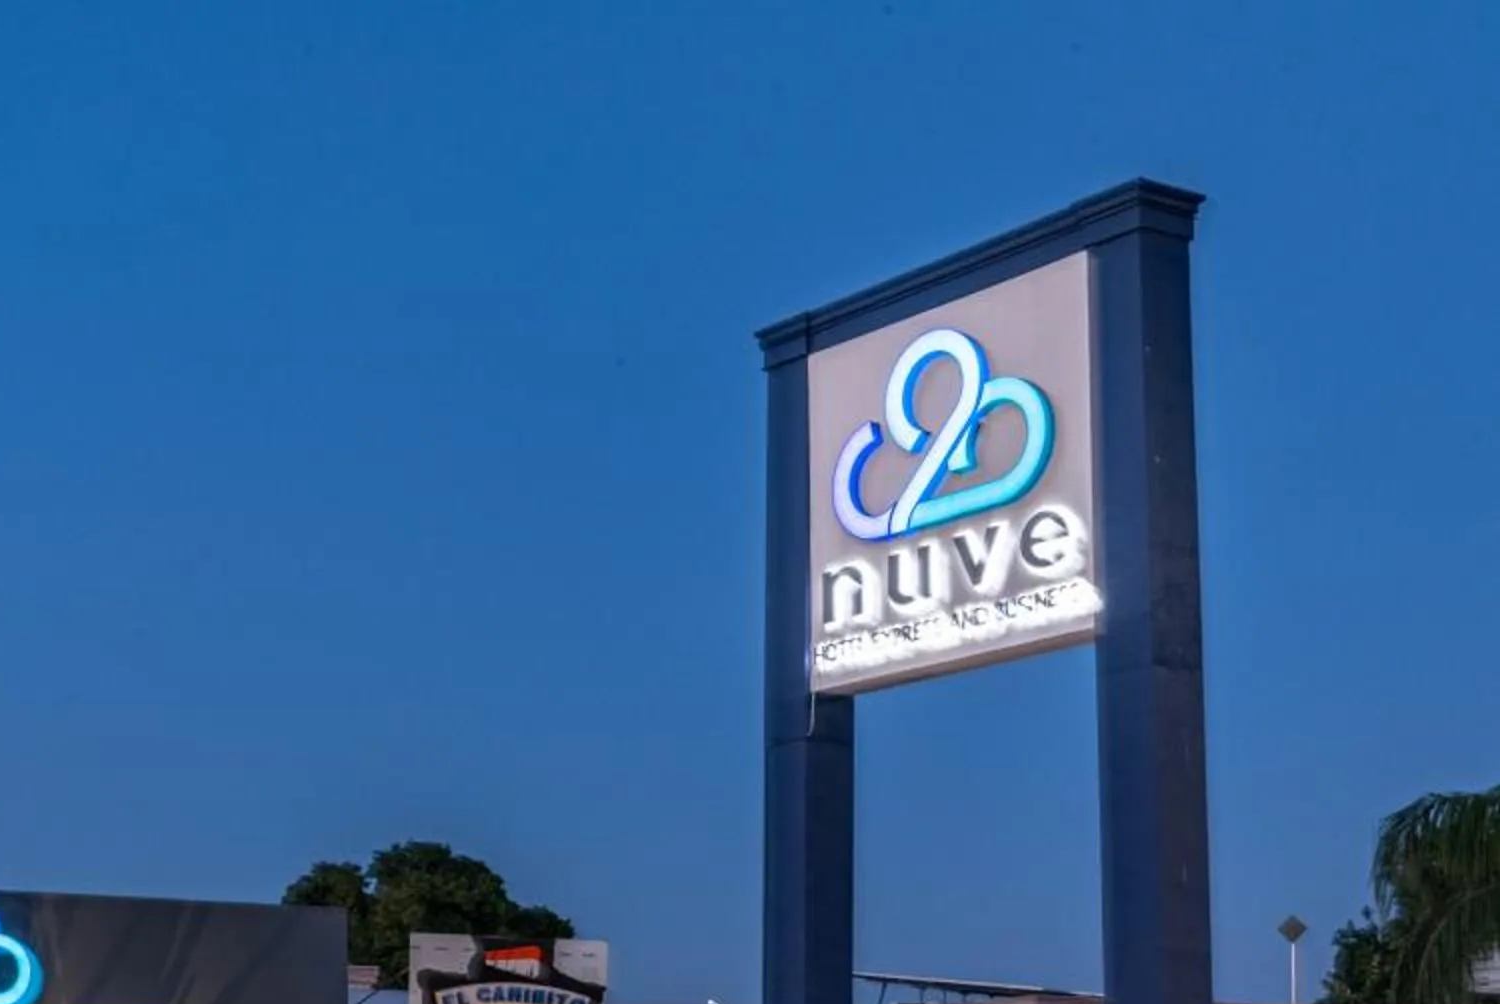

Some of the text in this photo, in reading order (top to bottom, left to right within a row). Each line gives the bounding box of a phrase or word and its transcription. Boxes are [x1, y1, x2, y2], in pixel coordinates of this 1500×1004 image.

[821, 508, 1071, 627] nuve
[813, 582, 1078, 664] HOT EXPRE AND BUSINE
